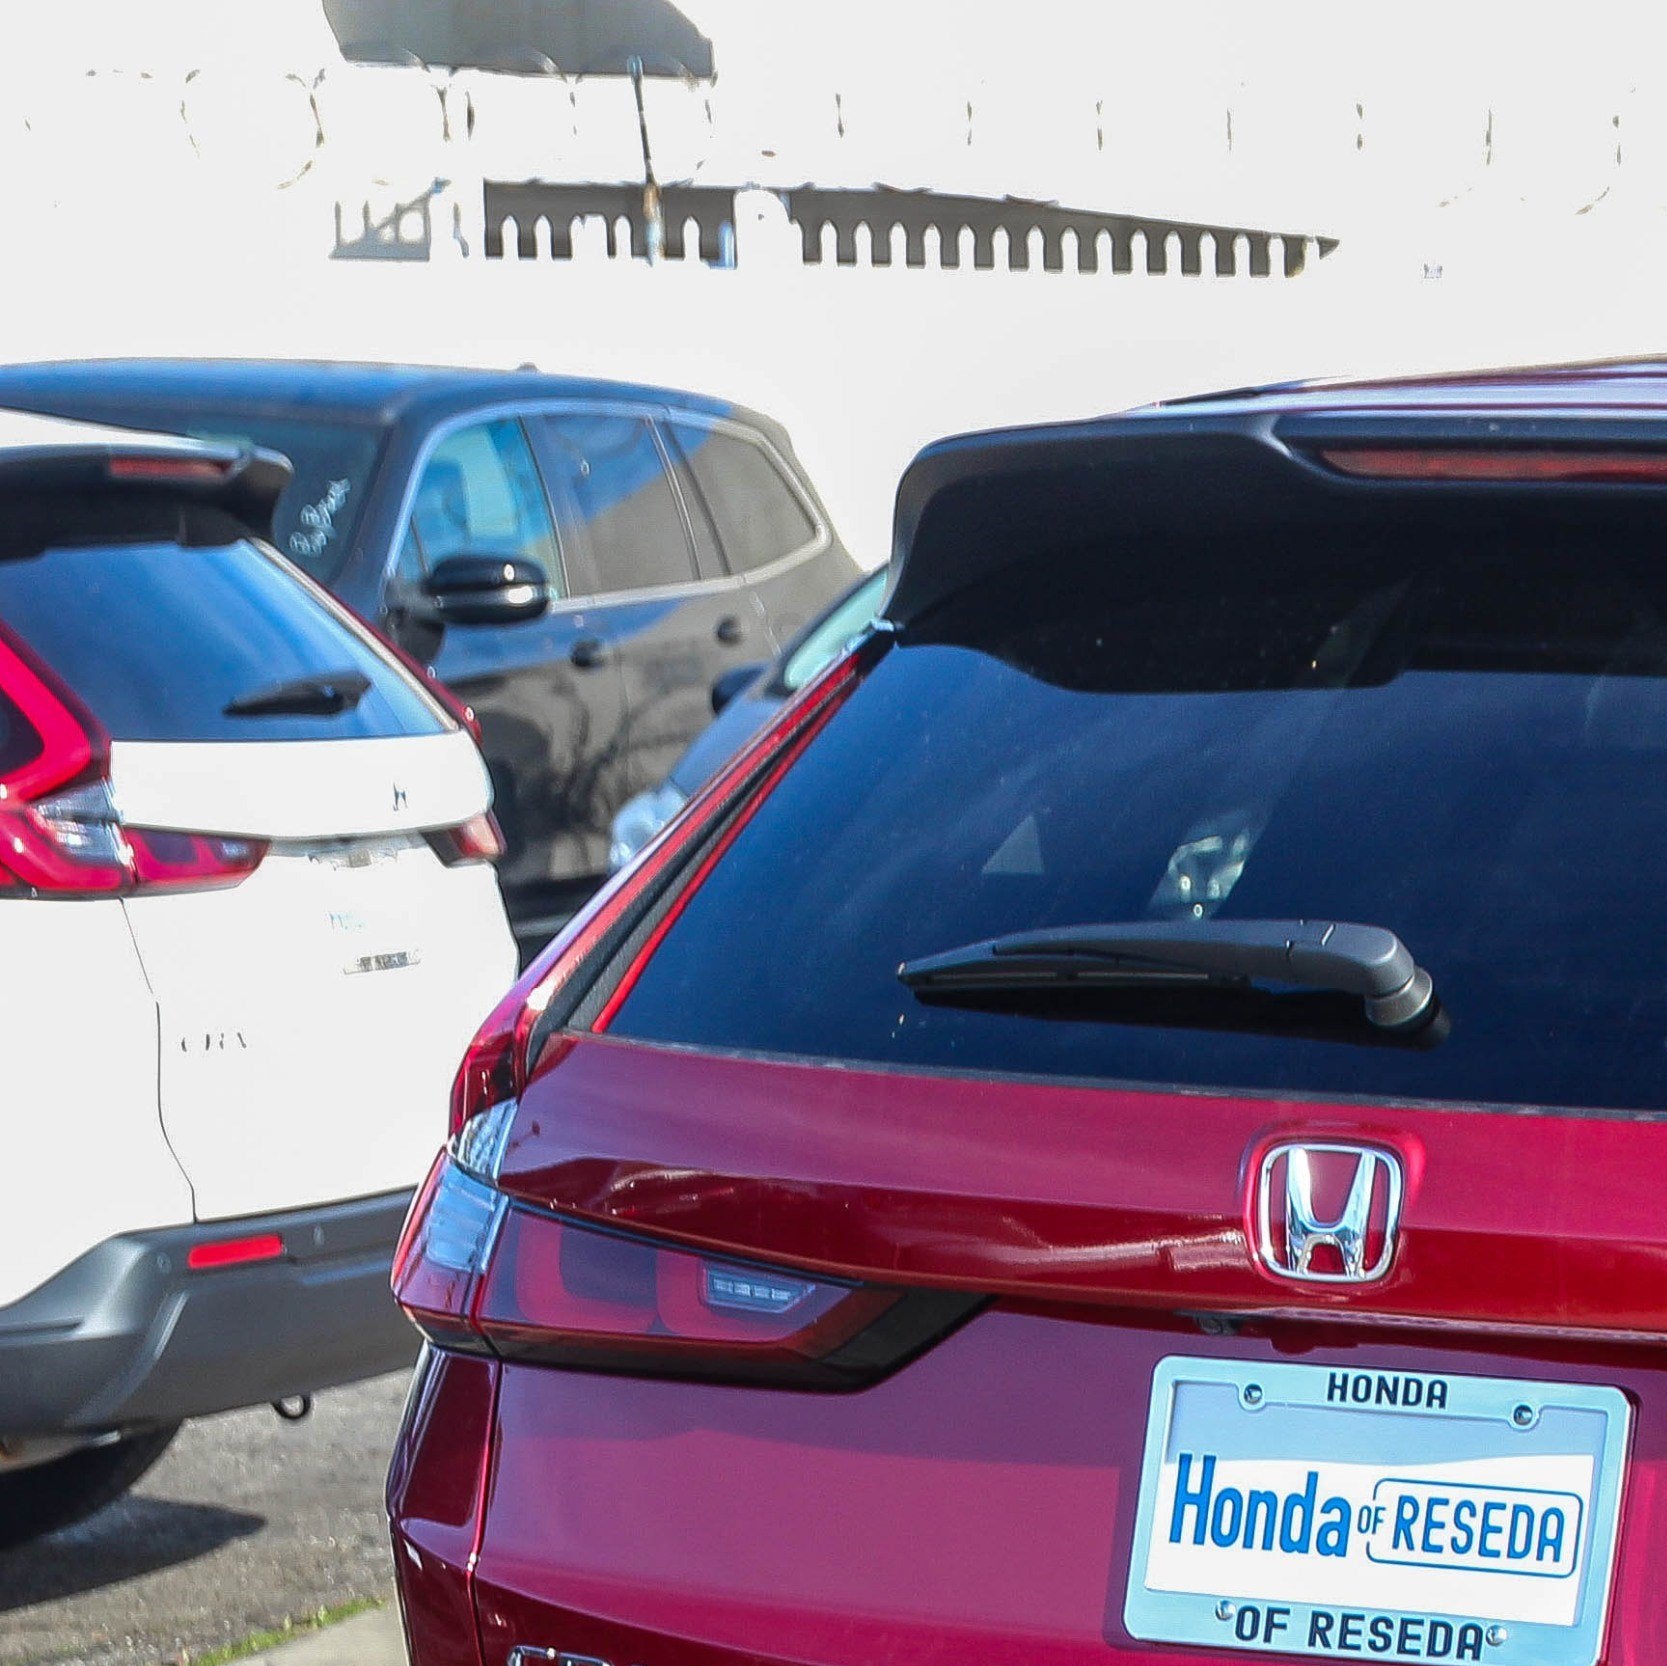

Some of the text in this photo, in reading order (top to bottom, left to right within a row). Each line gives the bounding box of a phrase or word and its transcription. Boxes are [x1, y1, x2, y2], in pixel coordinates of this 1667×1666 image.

[1326, 1373, 1449, 1409] HONDA
[1168, 1453, 1566, 1563] Honda OF RESEDA
[1235, 1605, 1485, 1662] OF RESEDA
